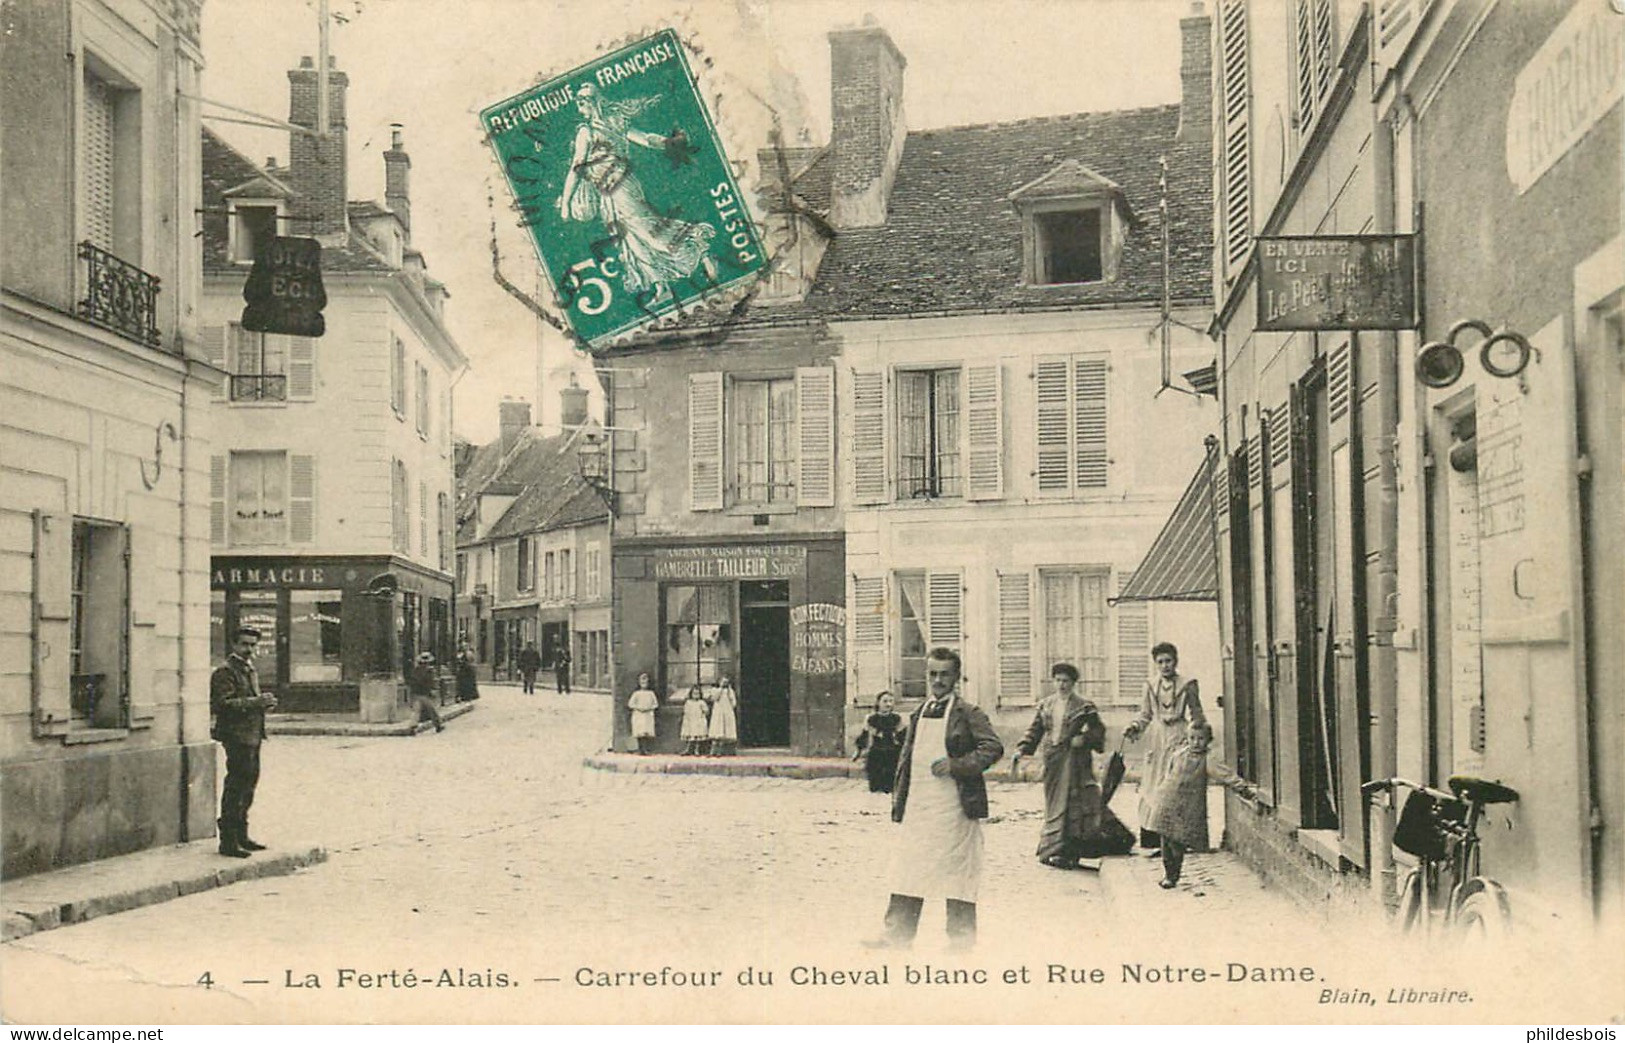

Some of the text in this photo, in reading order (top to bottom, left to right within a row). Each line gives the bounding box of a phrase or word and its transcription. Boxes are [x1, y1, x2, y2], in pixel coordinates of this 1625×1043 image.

[595, 42, 675, 88] FRANÇAISE
[710, 182, 757, 263] POSTES
[1265, 241, 1350, 257] EN VENTE
[1274, 259, 1308, 273] ICI
[1266, 290, 1287, 322] Le
[717, 558, 768, 577] TAILLEUR
[795, 632, 842, 648] HOMMES
[792, 655, 845, 673] ENFANTS
